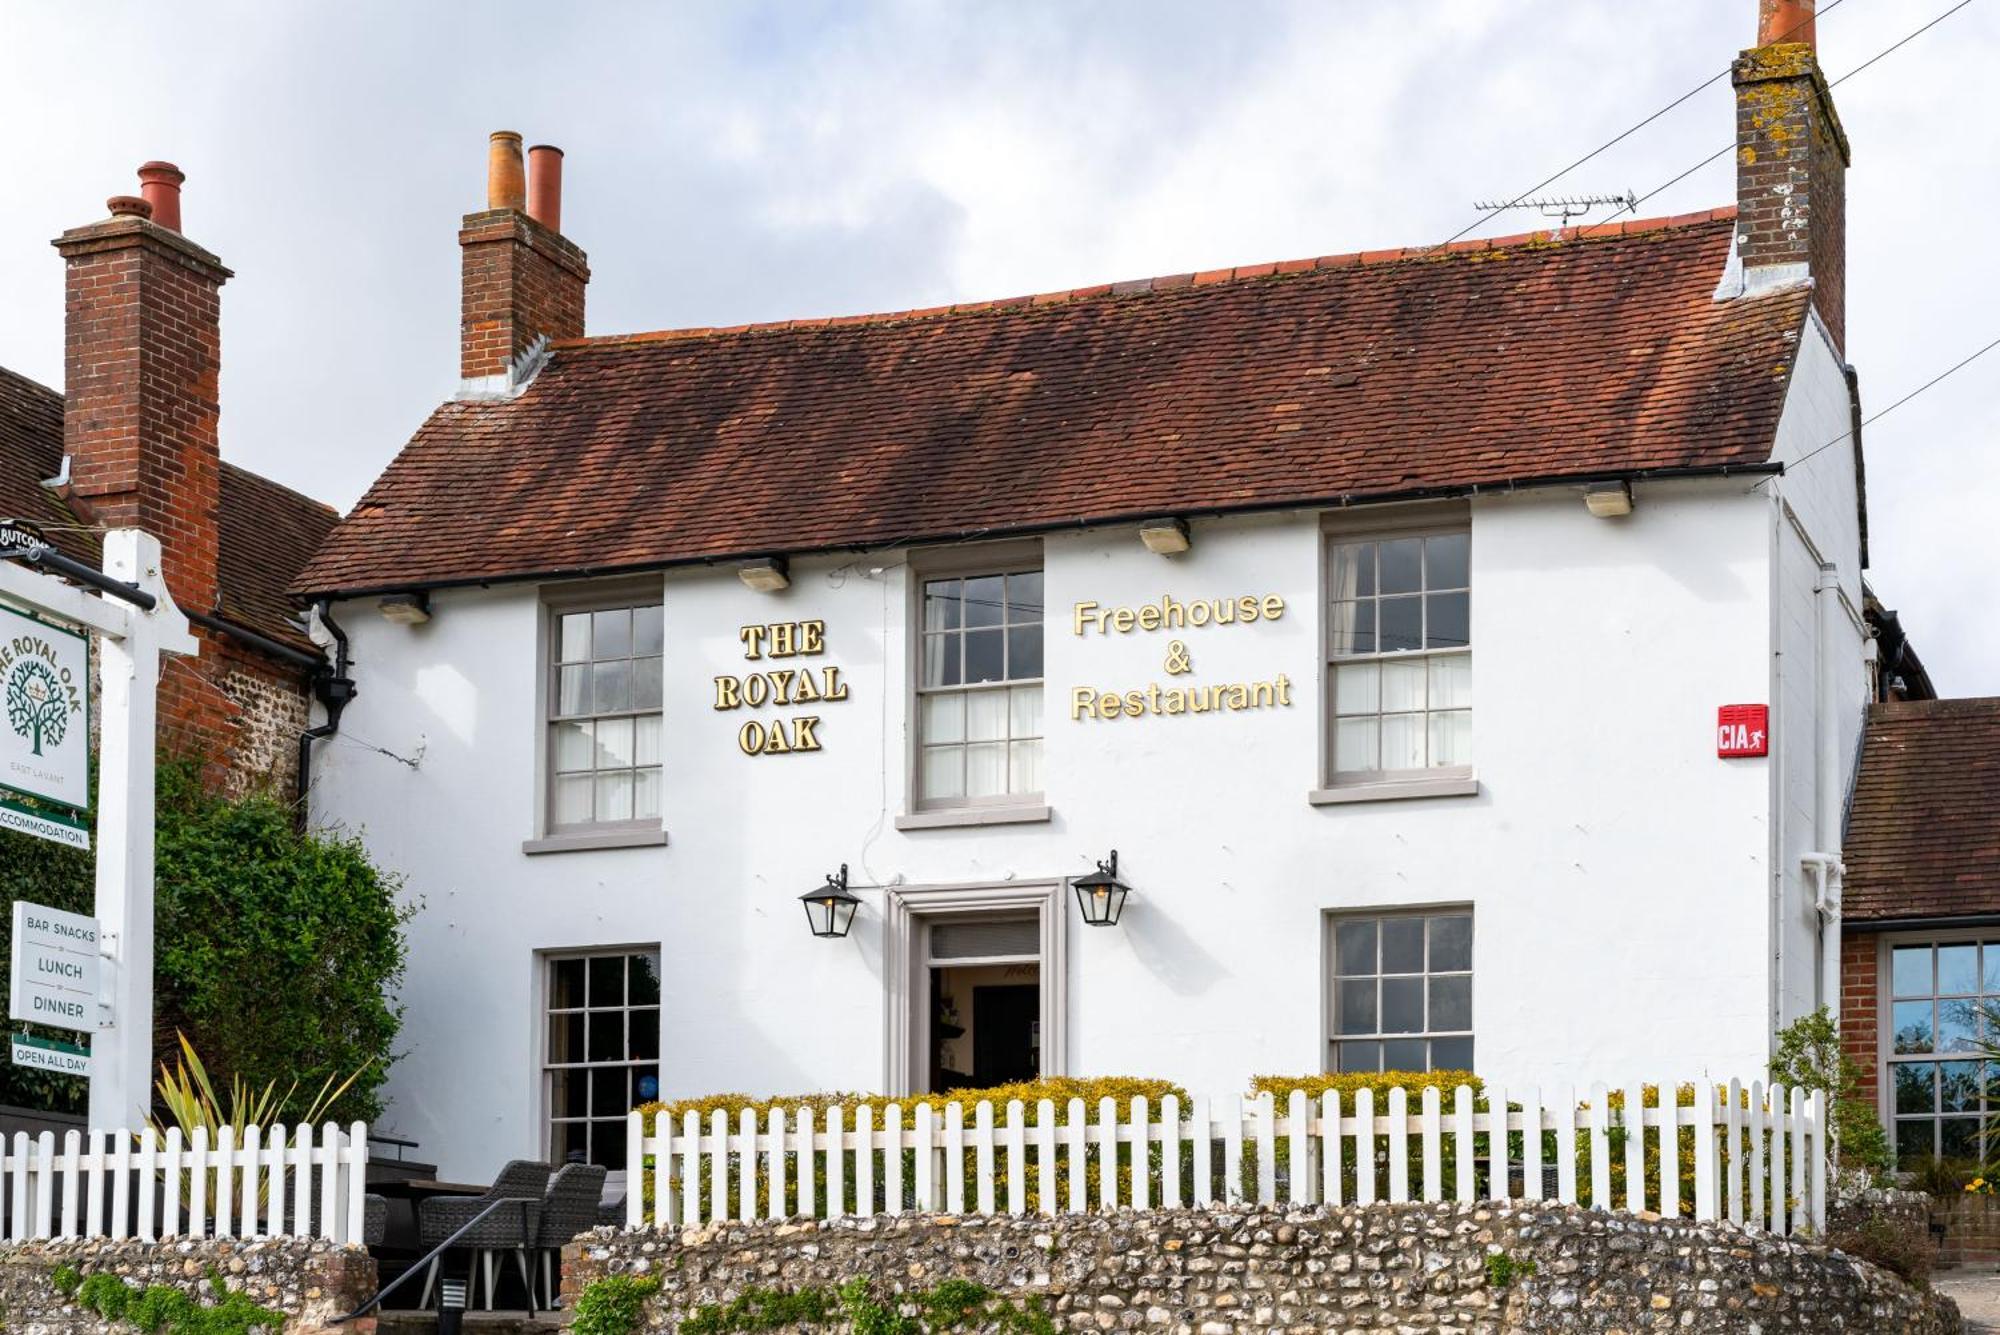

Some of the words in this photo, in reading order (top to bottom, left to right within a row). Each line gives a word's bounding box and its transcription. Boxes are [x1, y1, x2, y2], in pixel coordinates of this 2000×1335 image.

[0, 527, 50, 549] BUTCOM
[1074, 592, 1285, 636] Freehouse
[740, 620, 825, 660] THE
[1163, 639, 1191, 676] &
[0, 646, 14, 684] HE
[12, 635, 57, 669] ROYAL
[60, 667, 82, 714] OAK
[714, 666, 848, 711] ROYAL
[1071, 673, 1290, 721] Restaurant
[739, 716, 822, 756] OAK
[1718, 724, 1749, 750] CIA
[10, 761, 31, 775] EAST
[0, 812, 83, 844] CCOMMODATION
[27, 917, 49, 933] BAR
[53, 923, 96, 943] SNACKS
[38, 957, 83, 980] LUNCH
[34, 996, 84, 1019] DINNER
[16, 1049, 45, 1065] OPEN
[47, 1054, 65, 1069] ALL
[67, 1058, 87, 1072] DAY
